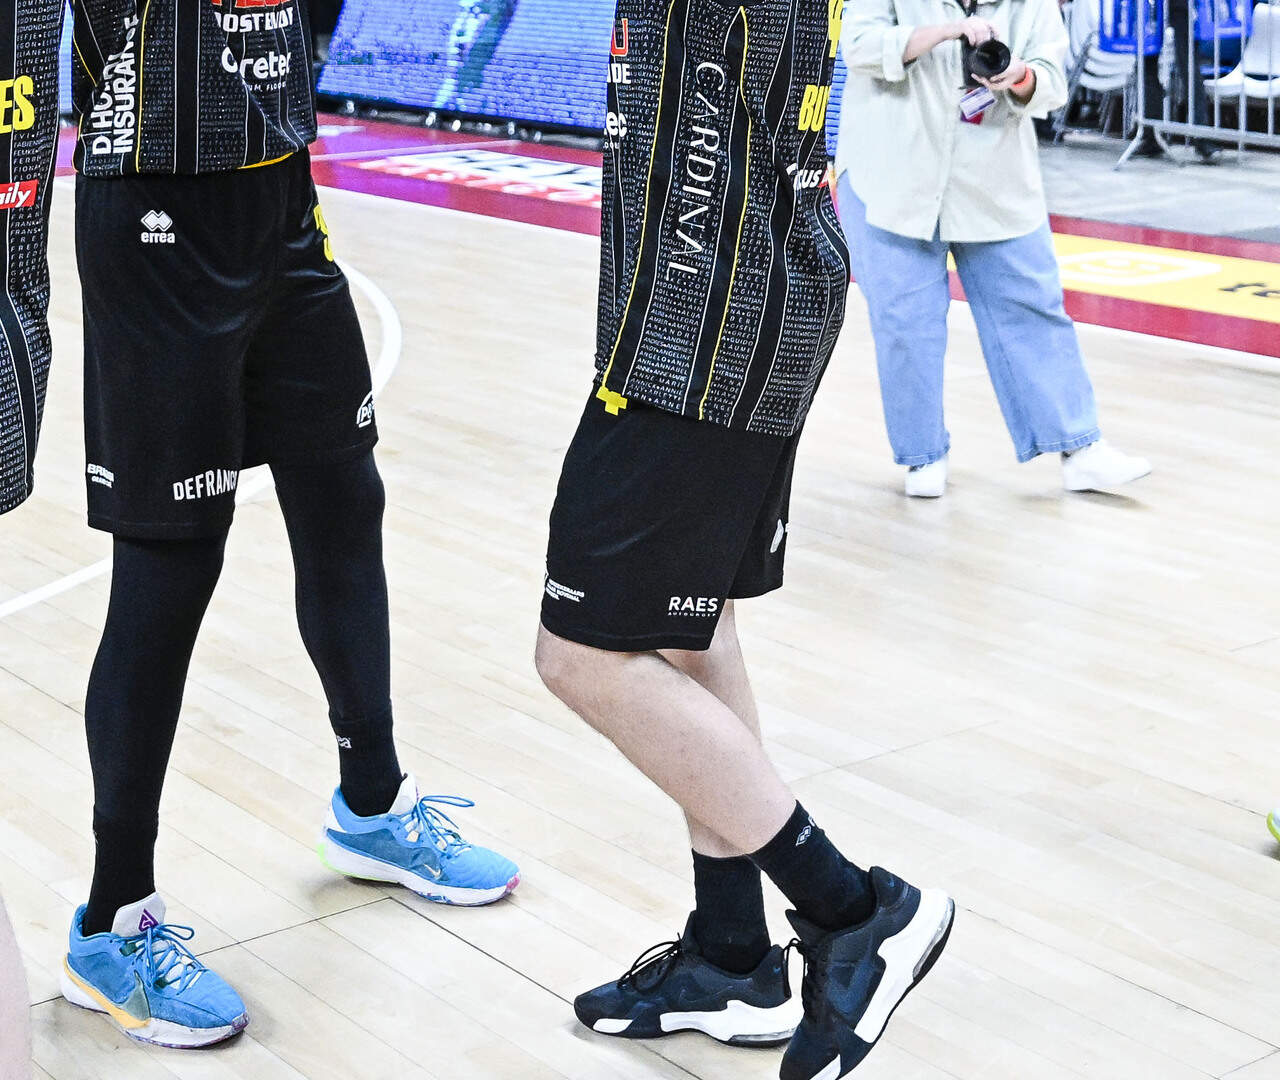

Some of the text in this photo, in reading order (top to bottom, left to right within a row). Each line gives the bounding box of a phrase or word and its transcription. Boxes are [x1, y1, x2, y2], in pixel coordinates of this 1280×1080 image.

[666, 62, 725, 281] CARDINAL
[140, 231, 175, 244] errea
[668, 596, 719, 612] RAES
